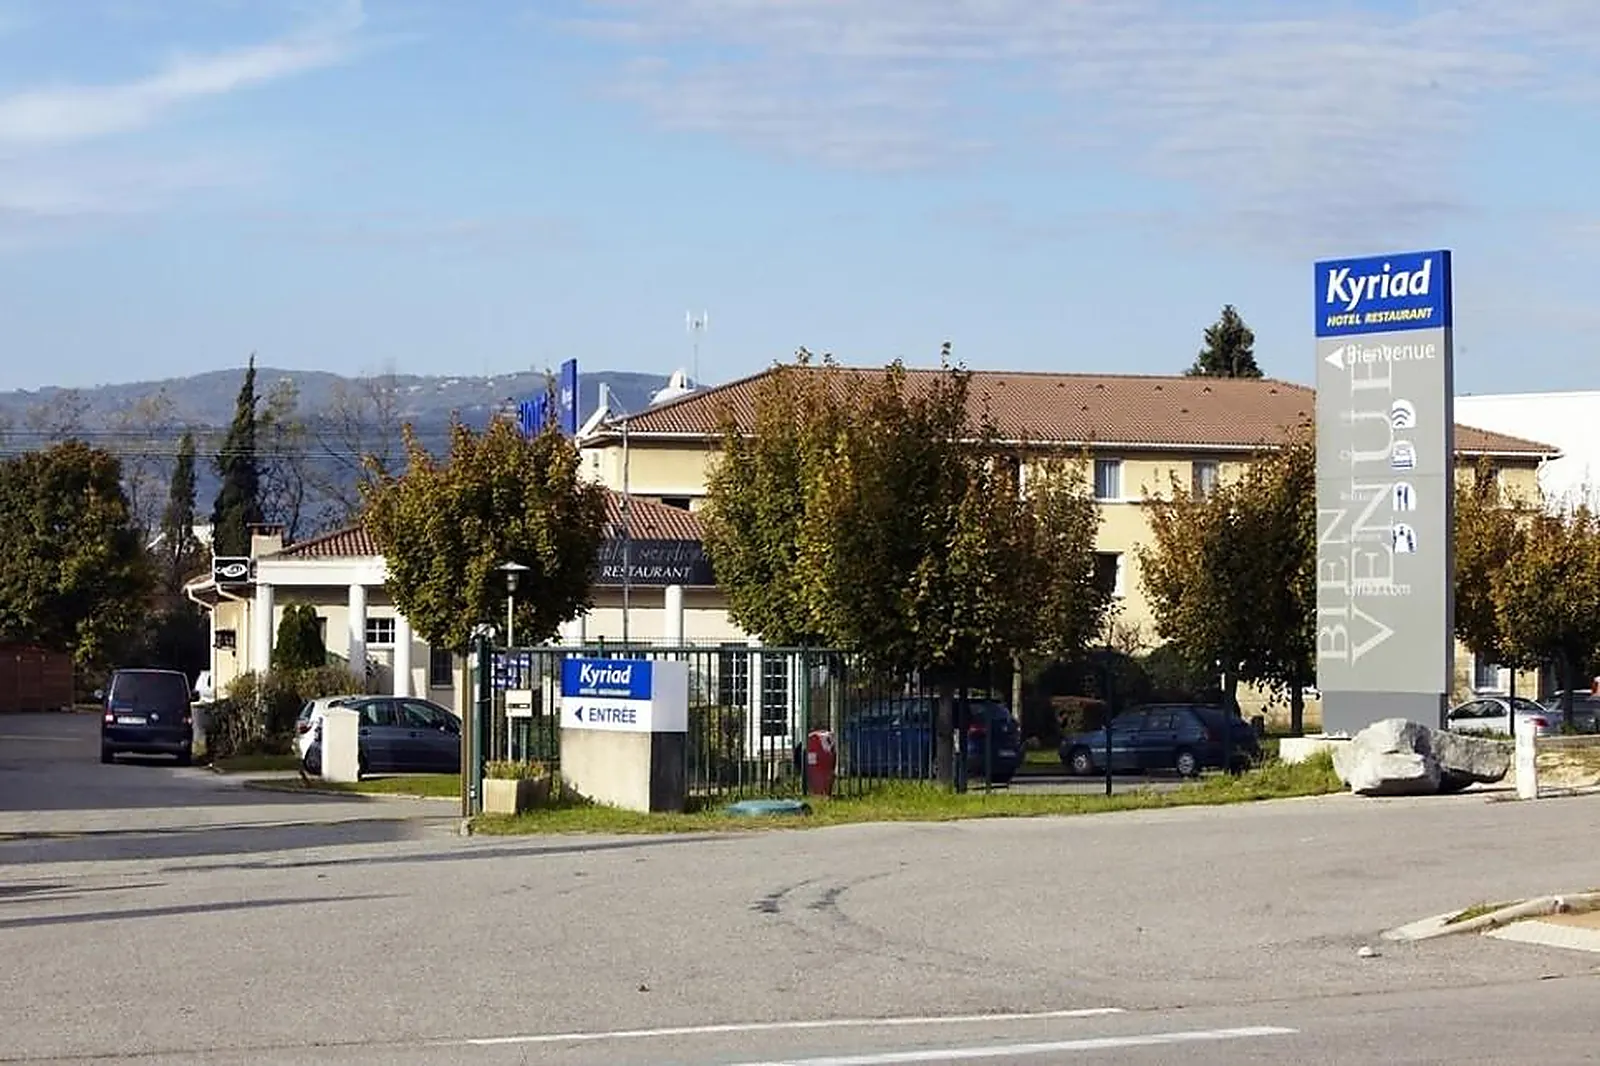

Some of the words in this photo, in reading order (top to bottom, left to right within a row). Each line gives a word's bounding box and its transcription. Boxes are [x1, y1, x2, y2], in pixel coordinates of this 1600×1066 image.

[1326, 259, 1432, 311] Kyriad
[1326, 313, 1361, 327] HOTEL
[1365, 307, 1434, 324] RESTAURANT
[1347, 344, 1435, 364] Bienvenue
[602, 565, 692, 578] RESTAURANT
[1317, 508, 1349, 662] BIEN
[579, 663, 632, 688] Kyriad
[589, 705, 636, 724] ENTRÉE
